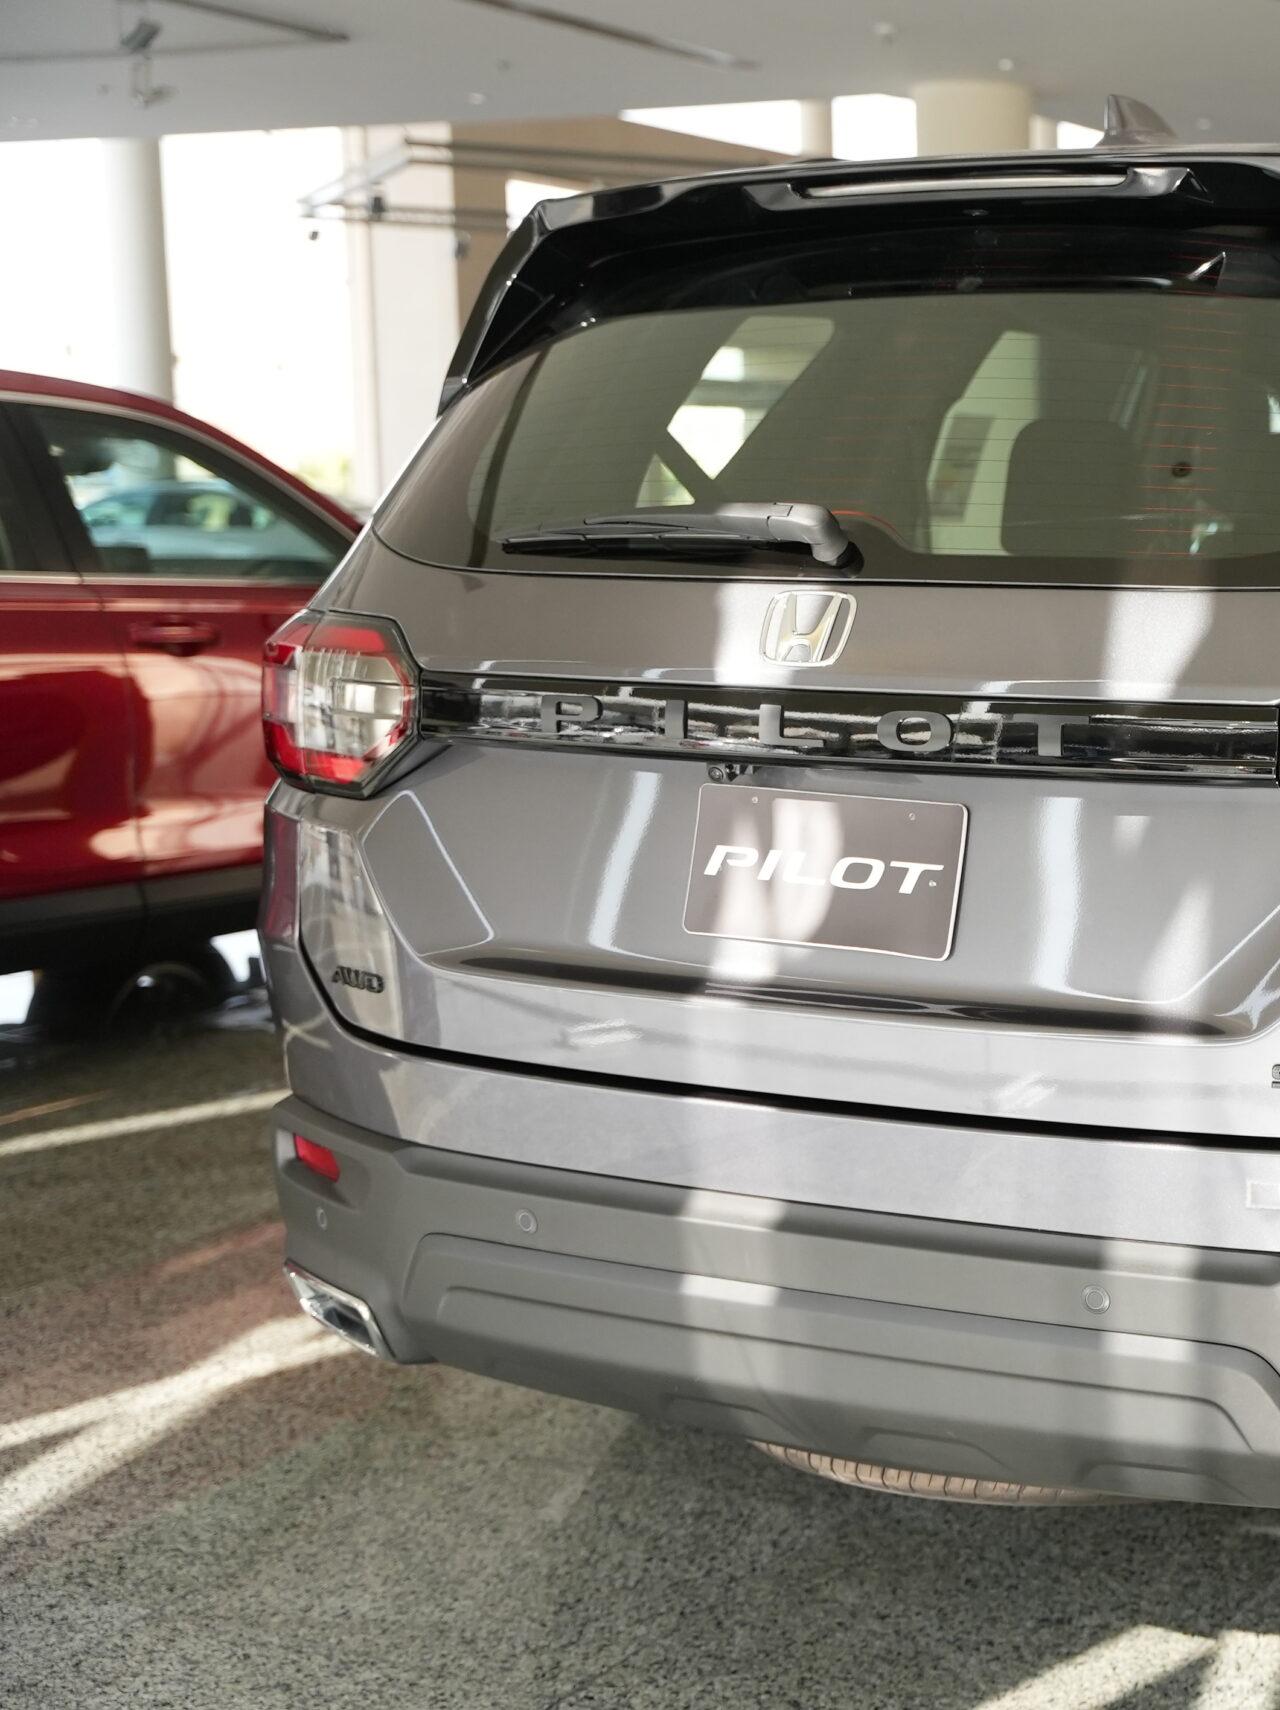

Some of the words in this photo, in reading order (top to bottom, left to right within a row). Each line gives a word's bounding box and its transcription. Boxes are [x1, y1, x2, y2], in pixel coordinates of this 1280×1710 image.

[541, 694, 1090, 757] PILOT
[703, 844, 945, 895] PILOT
[331, 965, 385, 994] AWD
